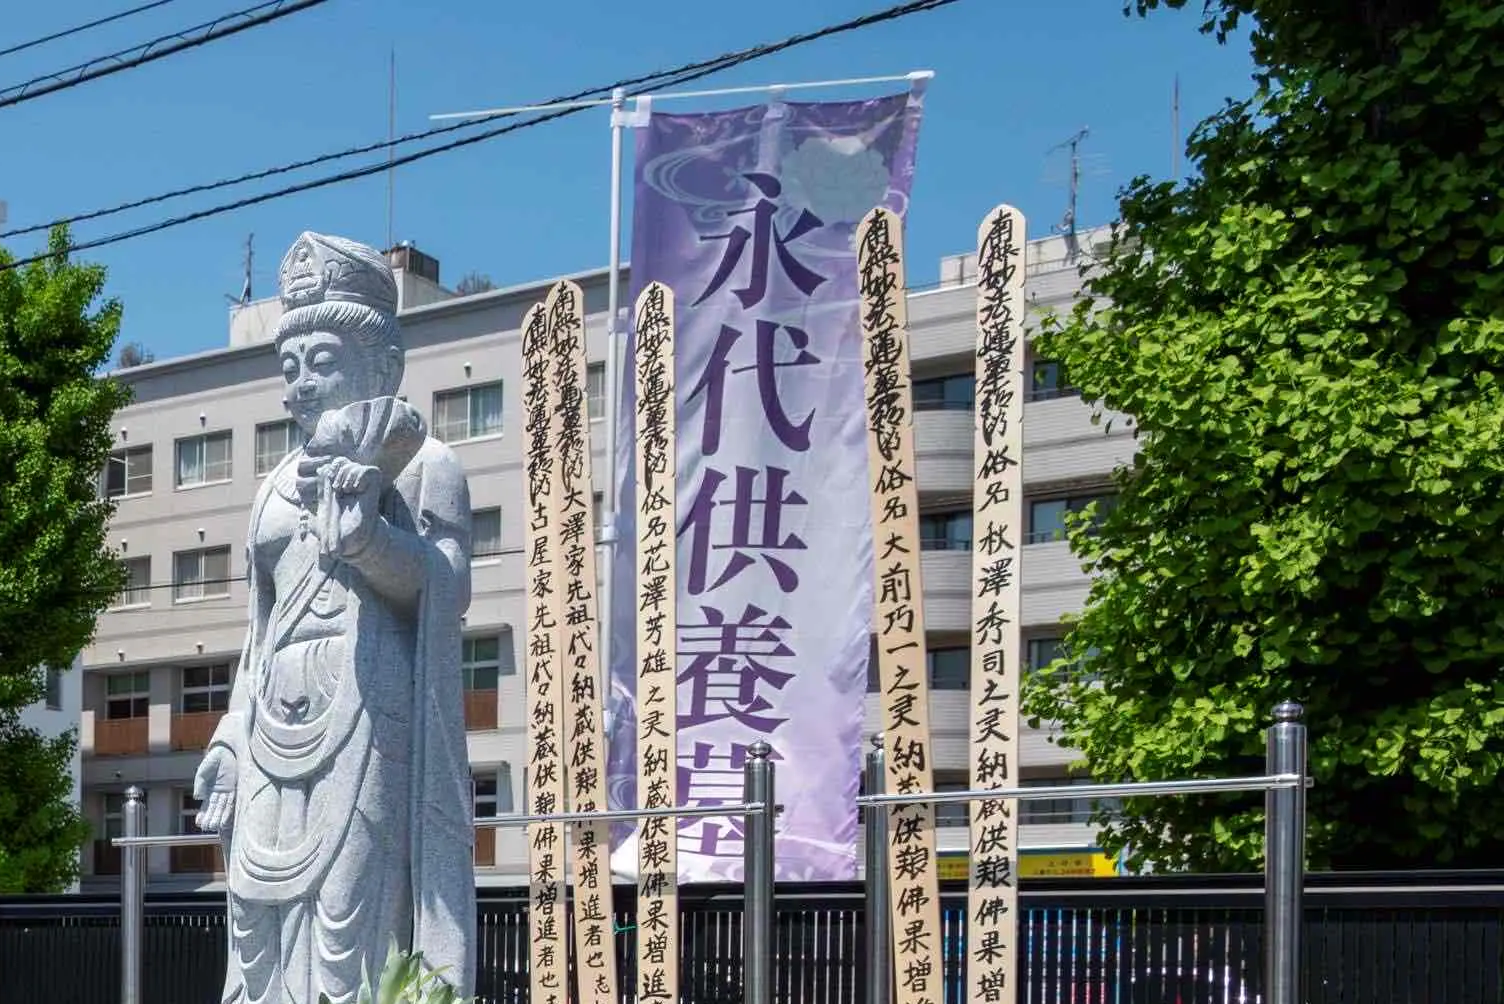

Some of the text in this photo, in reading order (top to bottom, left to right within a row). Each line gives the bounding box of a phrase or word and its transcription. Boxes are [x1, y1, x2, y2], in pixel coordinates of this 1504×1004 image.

[675, 172, 829, 857] 永代供養墓
